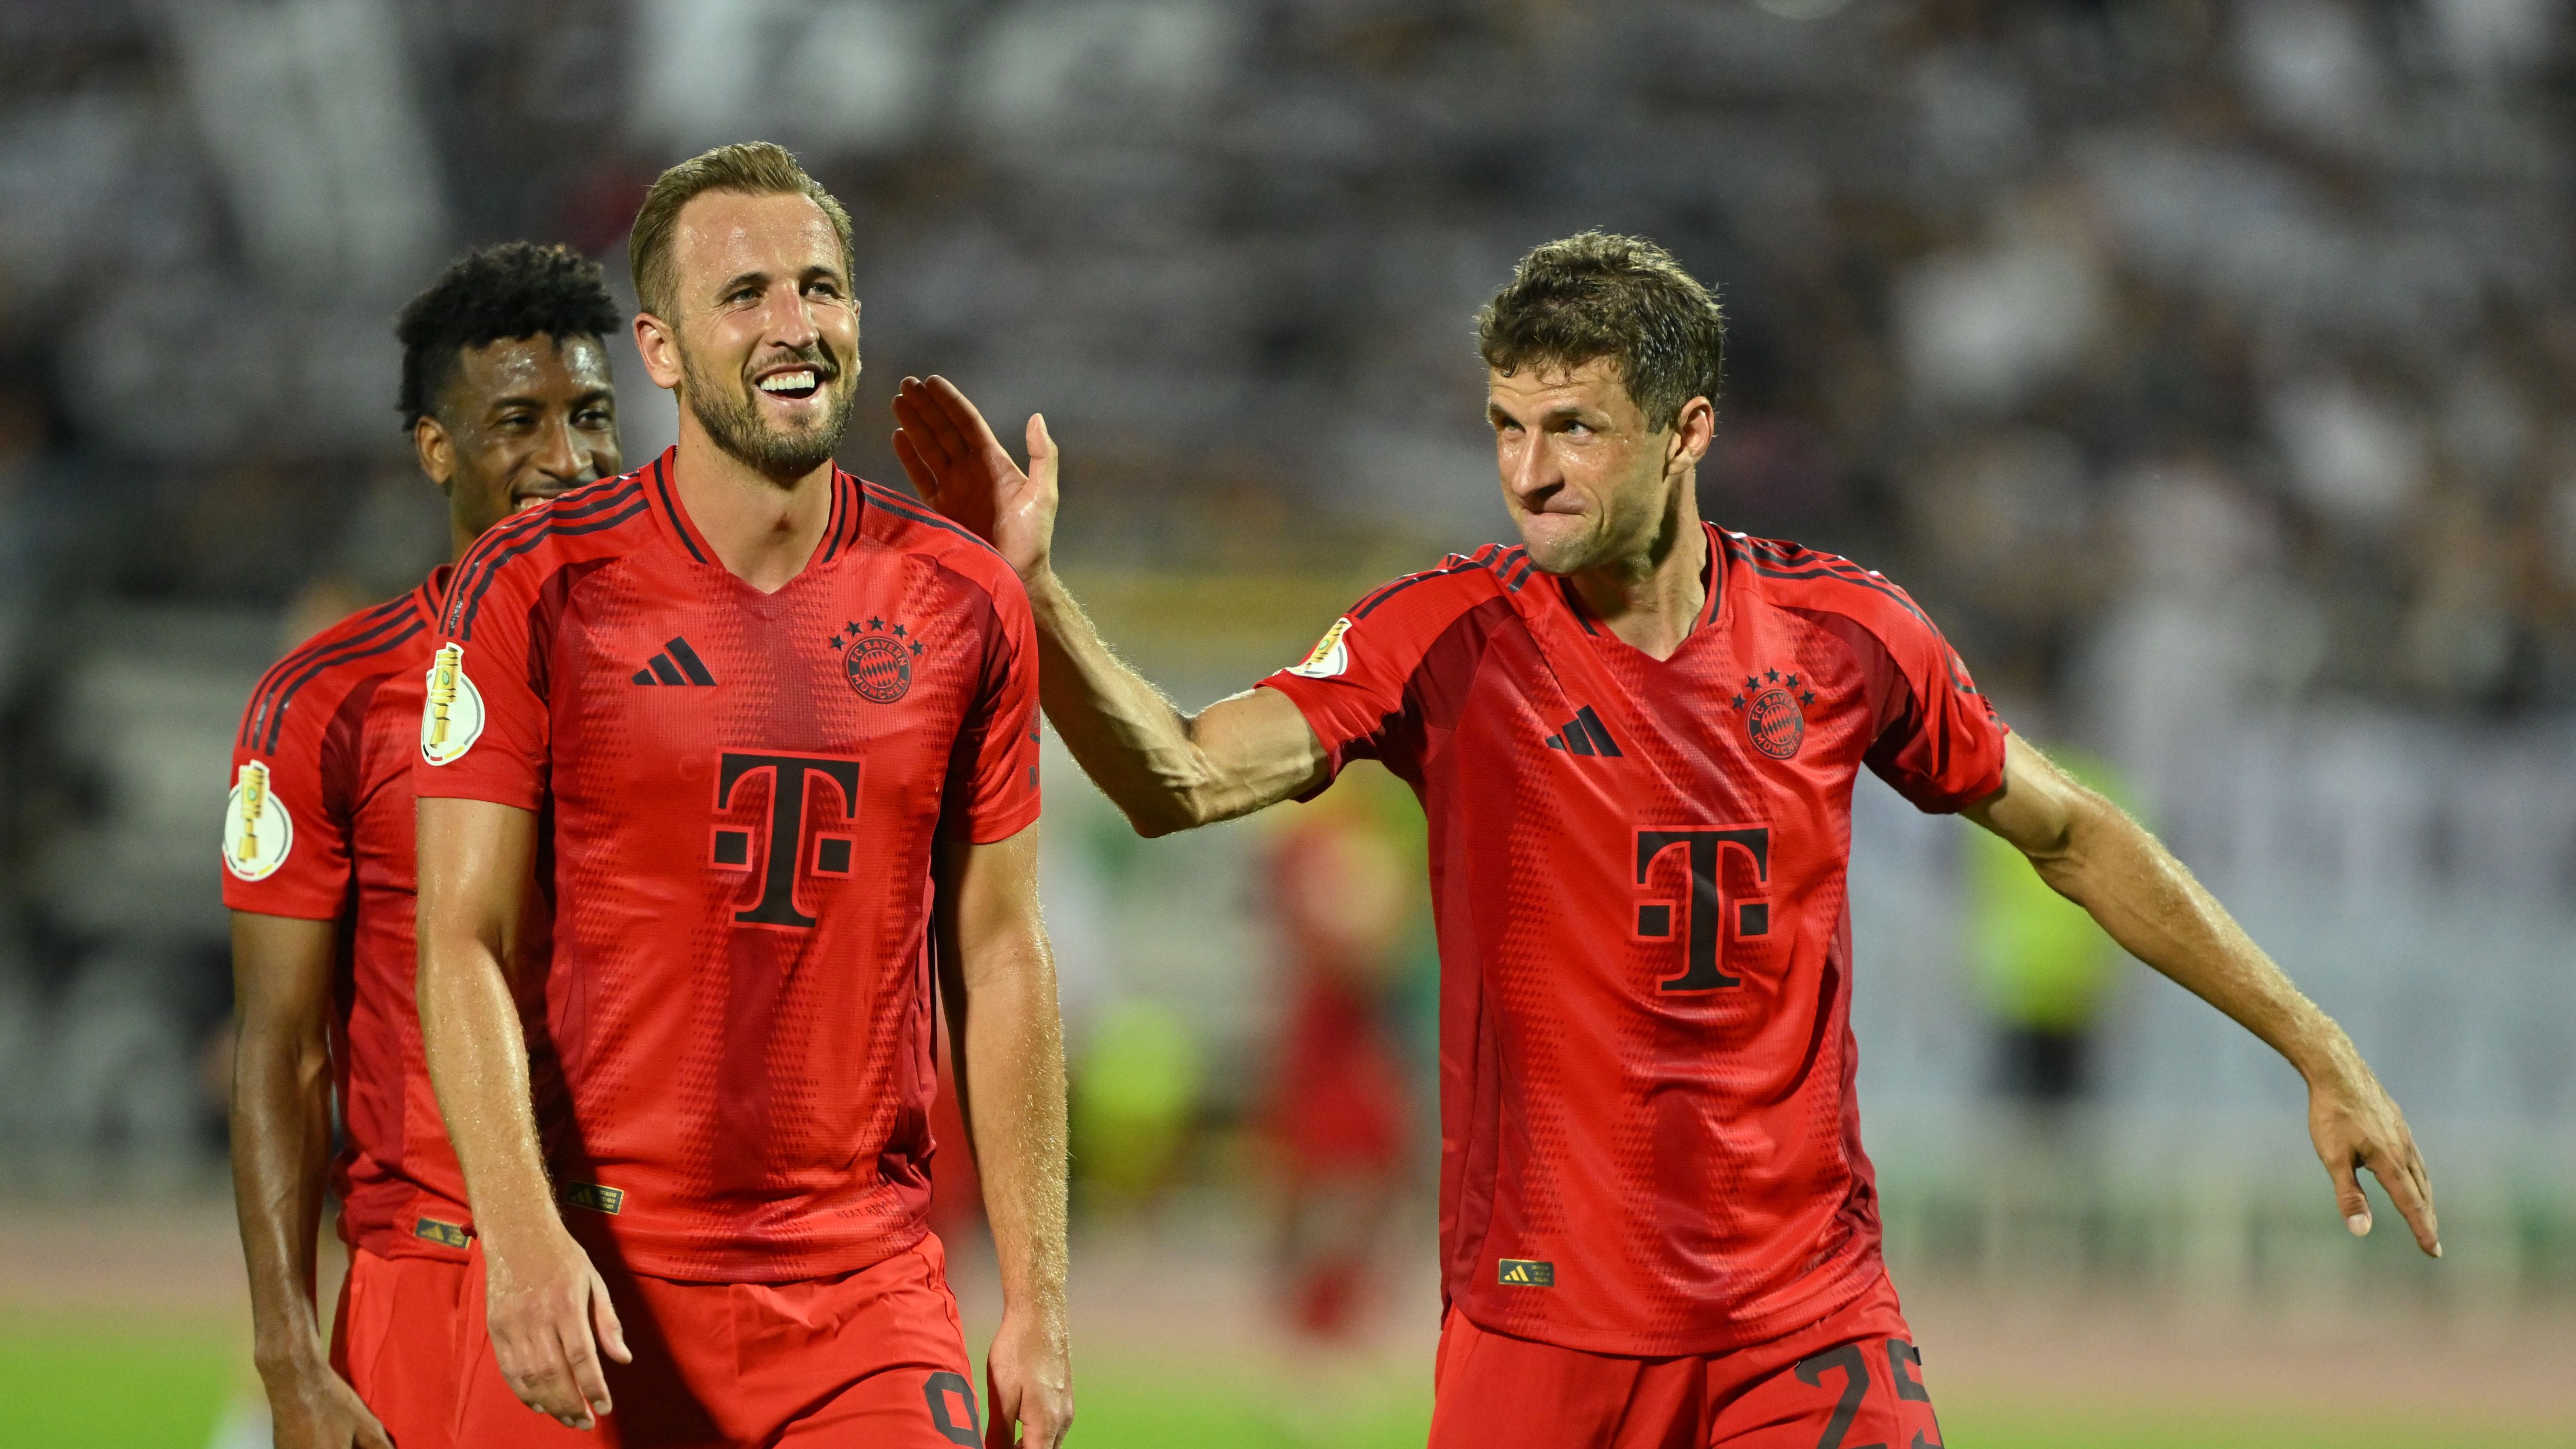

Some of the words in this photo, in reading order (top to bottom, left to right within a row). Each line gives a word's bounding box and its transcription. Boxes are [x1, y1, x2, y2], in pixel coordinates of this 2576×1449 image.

[851, 648, 863, 662] FC
[863, 641, 907, 666] BAYERN
[1752, 705, 1764, 721] FC
